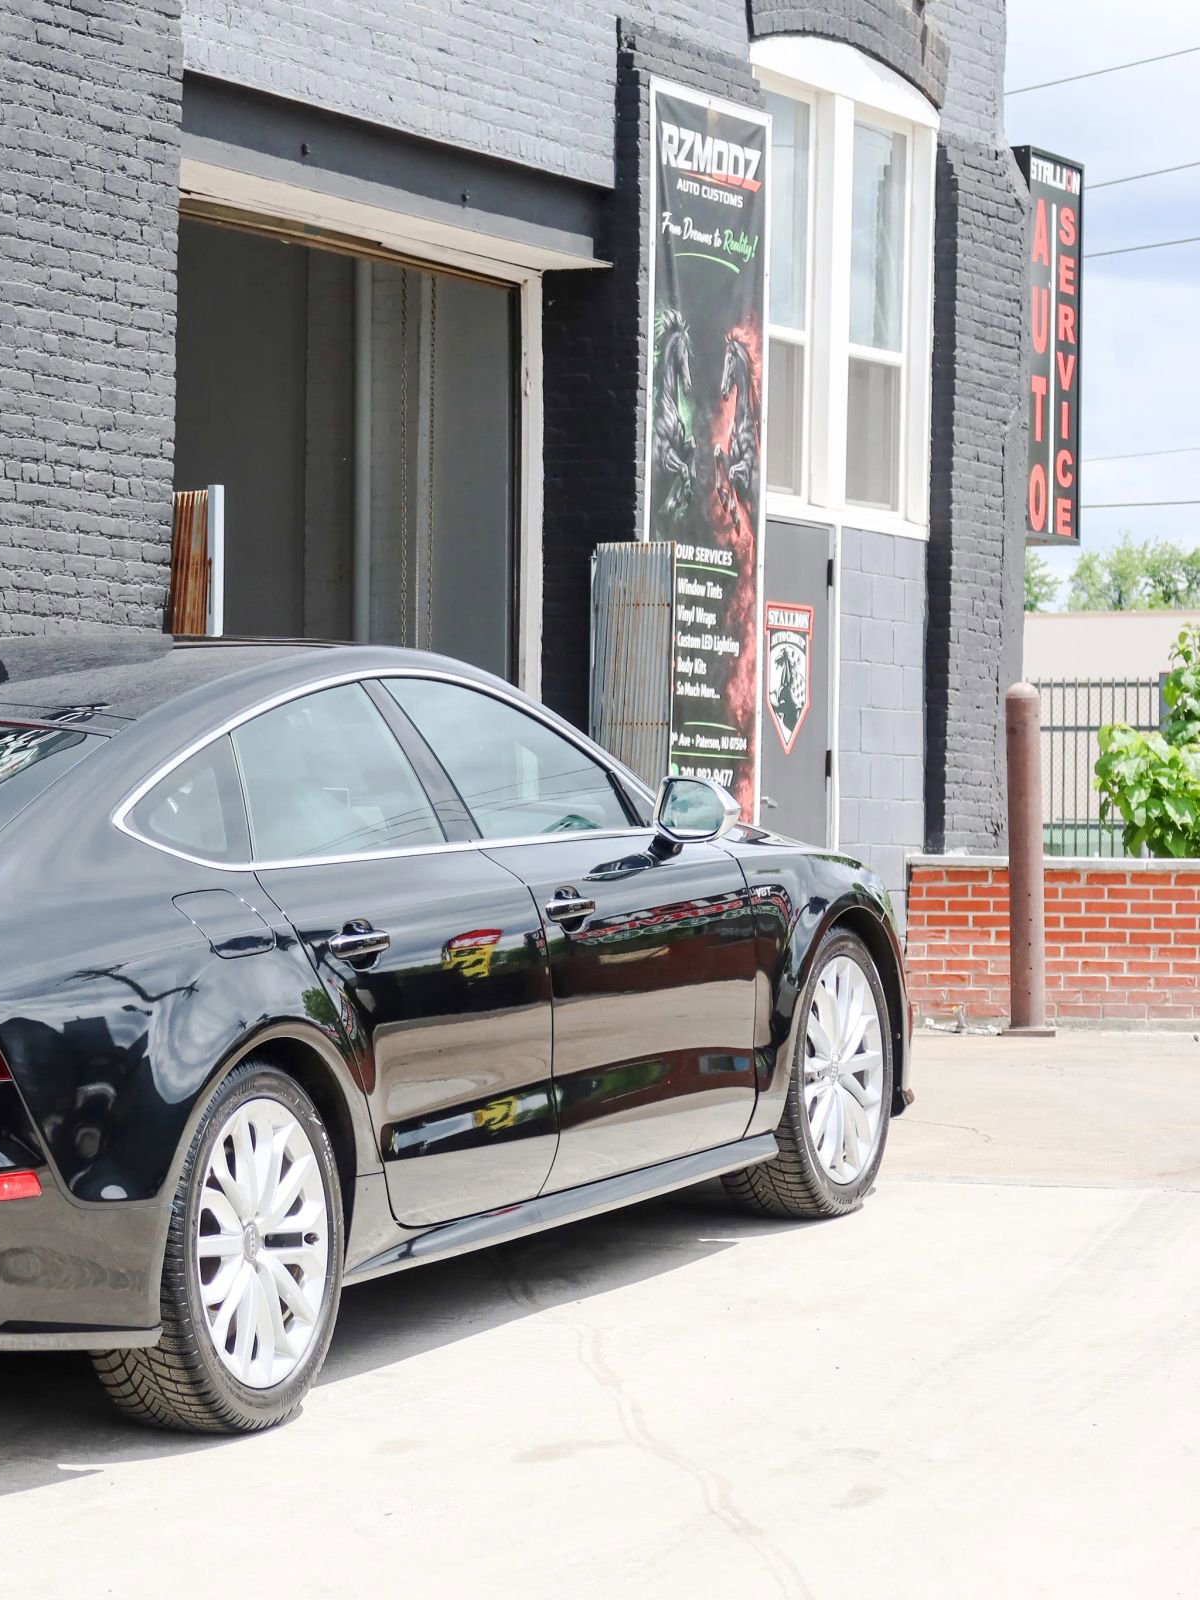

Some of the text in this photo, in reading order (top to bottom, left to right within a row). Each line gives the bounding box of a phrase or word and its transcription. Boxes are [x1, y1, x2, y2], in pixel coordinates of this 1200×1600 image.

[661, 121, 762, 192] RZMODZ
[1030, 156, 1080, 195] STALLION
[677, 178, 744, 208] AUTO CUSTOMS
[662, 211, 759, 262] From Dreams to Reality!
[1029, 197, 1049, 532] AUTO
[1055, 206, 1076, 536] SERVICE
[676, 544, 733, 566] OUR SERVICES
[677, 577, 723, 599] Window Tints
[677, 604, 717, 629] Vinyl Wraps
[768, 610, 809, 629] STALLION
[677, 631, 740, 657] Custom LED Lighting
[677, 656, 707, 677] Body Kits
[685, 682, 700, 697] Much
